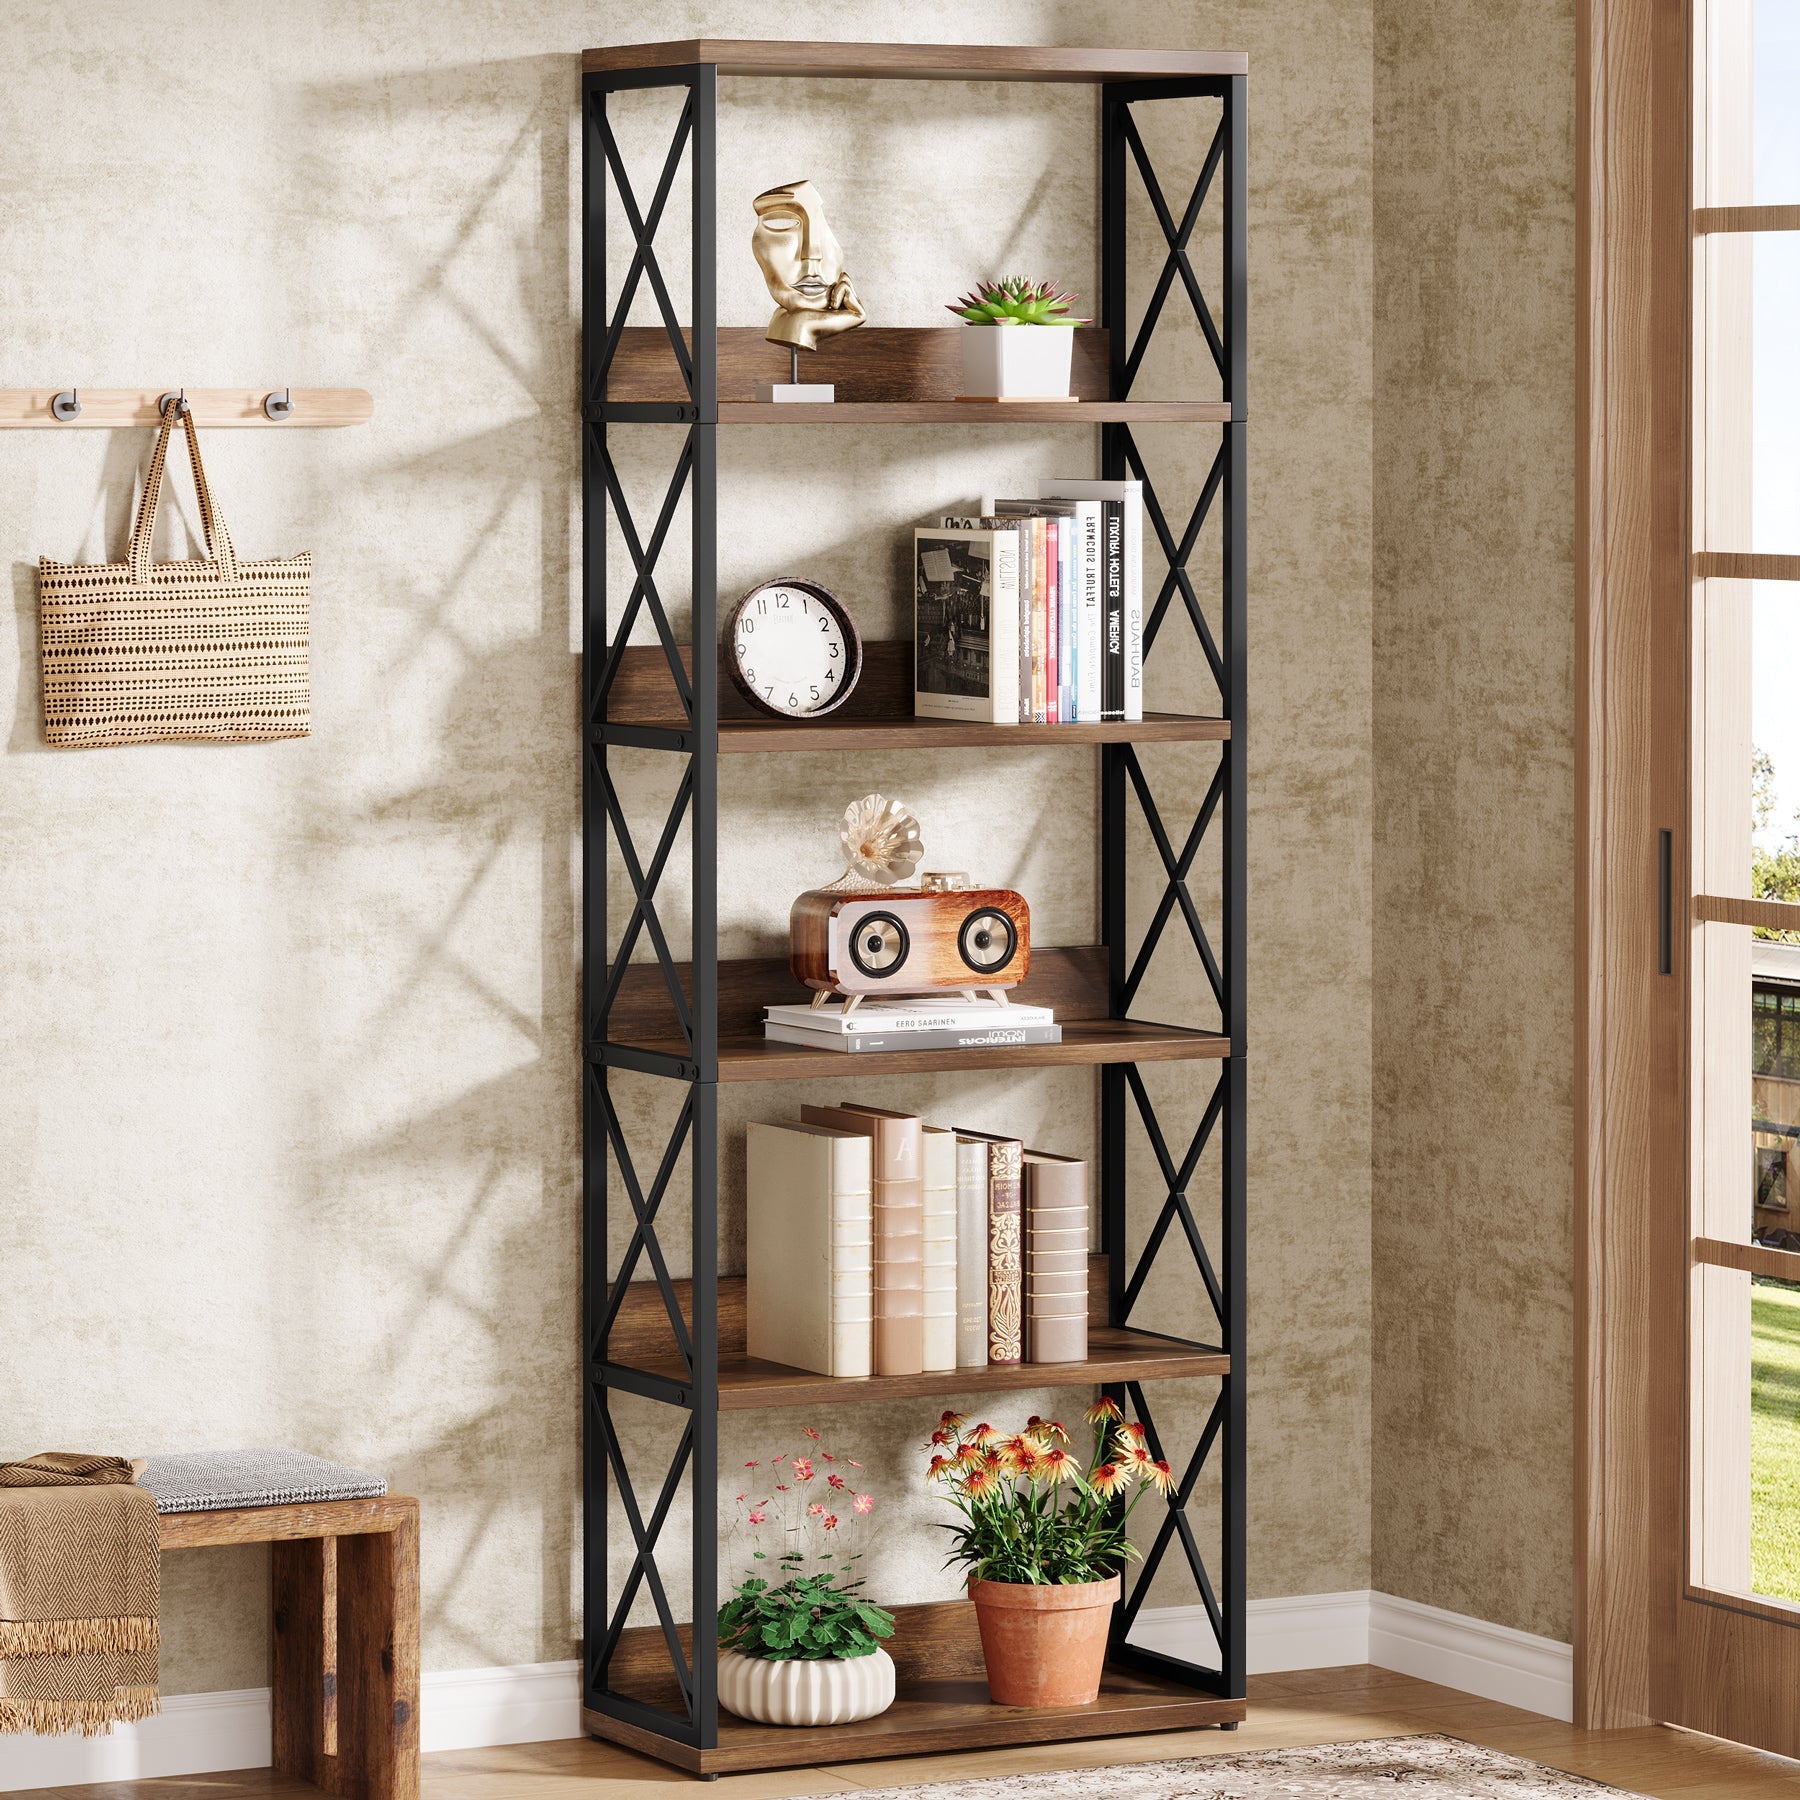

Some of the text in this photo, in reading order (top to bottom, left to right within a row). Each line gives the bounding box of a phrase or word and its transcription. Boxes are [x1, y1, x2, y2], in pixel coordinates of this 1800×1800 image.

[757, 599, 767, 615] 11
[775, 593, 790, 609] 12
[803, 599, 808, 615] 1
[739, 618, 755, 634] 10
[818, 617, 830, 632] 2
[737, 643, 747, 659] 9
[828, 642, 839, 658] 3
[746, 668, 756, 684] 8
[824, 667, 835, 682] 4
[764, 686, 774, 700] 7
[788, 692, 799, 708] 6
[809, 685, 820, 701] 5
[895, 1018, 956, 1028] EERO SAARINEN
[958, 1035, 1026, 1046] INTERIORS
